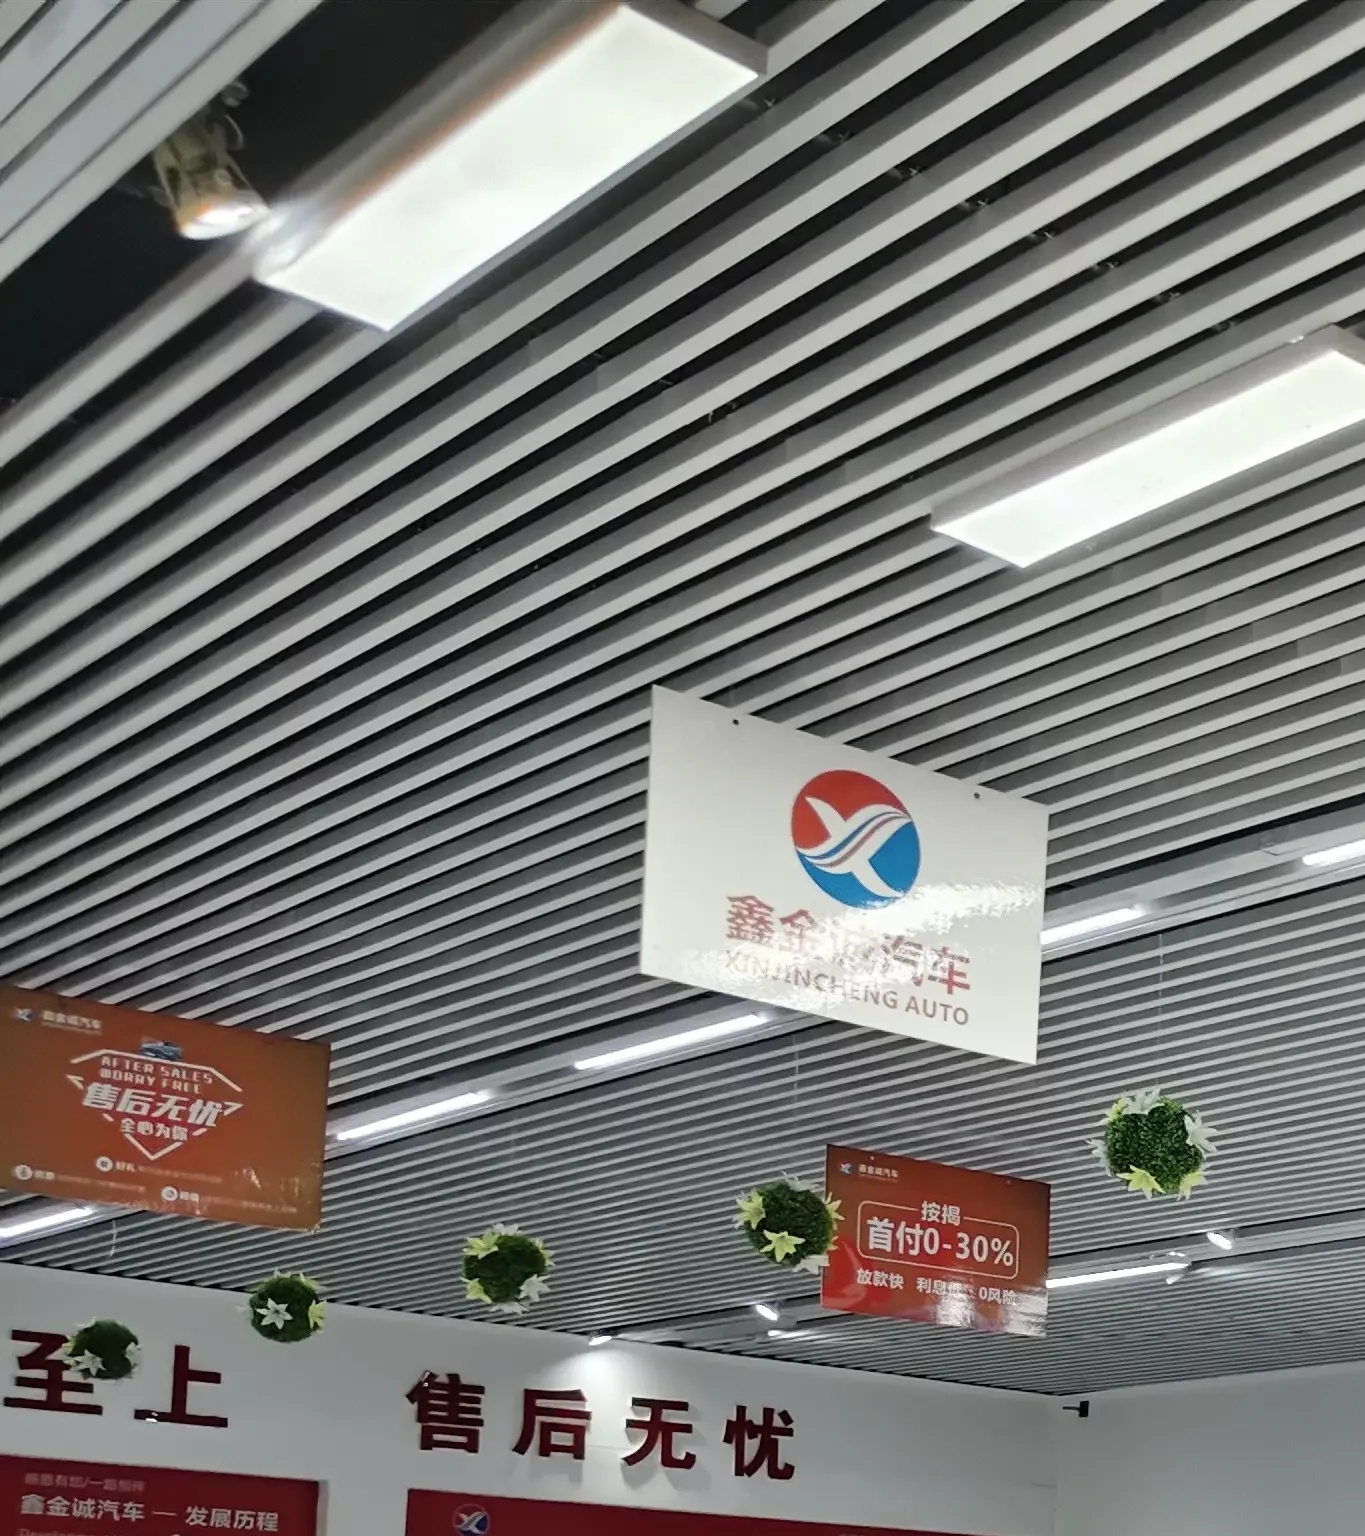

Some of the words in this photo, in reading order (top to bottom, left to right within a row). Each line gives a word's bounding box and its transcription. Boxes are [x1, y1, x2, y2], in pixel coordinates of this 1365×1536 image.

[726, 895, 970, 995] 鑫金汽车
[905, 995, 969, 1026] AUTO
[100, 1056, 154, 1074] AFTER
[160, 1065, 213, 1084] SALES
[82, 1082, 224, 1127] 售后无忧
[921, 1201, 961, 1226] 按揭
[866, 1216, 1014, 1267] 首付0-30%
[856, 1268, 904, 1290] 放款快
[406, 1371, 796, 1481] 售后无忧
[21, 1493, 145, 1523] 鑫金诚汽车
[185, 1505, 279, 1532] 发展历程
